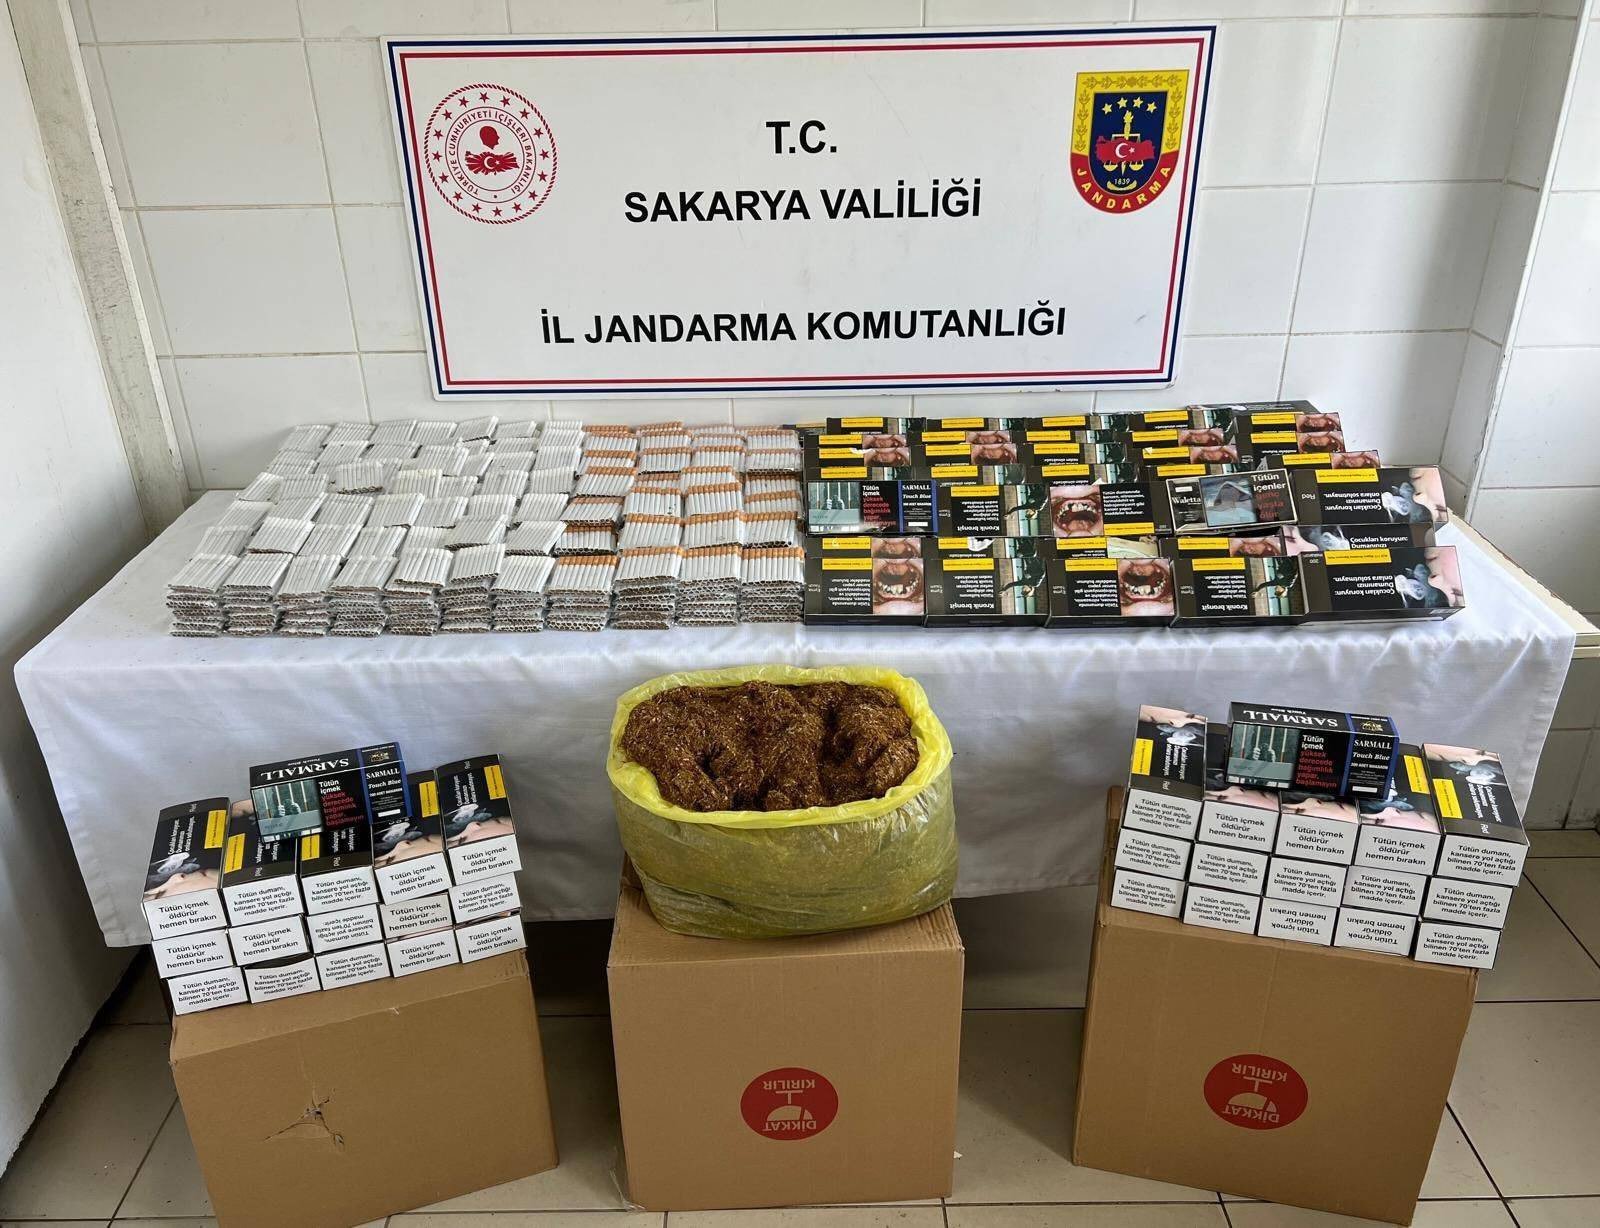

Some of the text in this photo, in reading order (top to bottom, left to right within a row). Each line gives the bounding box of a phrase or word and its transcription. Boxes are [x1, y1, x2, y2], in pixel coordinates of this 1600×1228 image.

[766, 121, 837, 154] T.C.
[449, 110, 532, 196] TÜRKİYE CUMHURİYETİ İÇİŞLERİ BAKANLIĞI
[1077, 167, 1171, 209] JANDARMA
[624, 178, 981, 222] SAKARYA VALİLİĞİ
[541, 300, 1066, 344] İL JANDARMA KOMUTANLIĞI
[1251, 474, 1279, 482] Tütün
[1253, 483, 1286, 492] içenler
[949, 602, 971, 610] bronşit
[1243, 710, 1338, 727] SARMALL
[1303, 734, 1324, 743] Tütün
[1354, 740, 1392, 749] SARMALL
[1302, 742, 1324, 751] içmek
[1301, 750, 1327, 758] yüksek
[1299, 757, 1332, 766] derecede
[261, 758, 349, 781] SARMALL
[366, 768, 400, 780] SARMALL
[1298, 765, 1333, 774] bağımlılık
[318, 779, 340, 787] Tütün
[368, 781, 387, 789] Touch
[1296, 778, 1337, 788] başlamayın
[320, 786, 341, 795] içmek
[323, 797, 354, 806] derecede
[1492, 805, 1502, 822] koruyun:
[1215, 813, 1265, 827] Tütün içmek
[1221, 822, 1250, 832] öldürür
[1292, 825, 1343, 839] Tütün içmek
[1480, 824, 1489, 834] Red
[1209, 828, 1265, 842] hemen bırakın
[1298, 834, 1329, 844] öldürür
[1286, 841, 1344, 854] hemen bırakın
[1372, 836, 1426, 850] Tütün içmek
[462, 845, 507, 861] Tütün içmek
[1378, 846, 1410, 855] öldürür
[1450, 851, 1480, 859] kansere
[1480, 848, 1512, 857] dumanı,
[470, 855, 497, 866] öldürür
[1365, 852, 1426, 865] hemen bırakın
[1472, 860, 1497, 868] 70'ten
[461, 858, 513, 875] hemen bırakın
[1455, 864, 1504, 876] madde içerir.
[1276, 872, 1304, 880] kansere
[1303, 870, 1331, 879] dumanı,
[1282, 886, 1326, 898] madde içerir.
[158, 899, 210, 913] Tütün içmek
[168, 909, 199, 919] öldürür
[1269, 907, 1325, 920] hemen bırakın
[159, 914, 217, 928] hemen bırakın
[1284, 917, 1313, 926] öldürür
[1270, 921, 1319, 934] Tütün içmek
[243, 926, 292, 942] Tütün içmek
[166, 940, 217, 954] Tütün içmek
[251, 936, 281, 947] öldürür
[243, 940, 299, 956] hemen bırakın
[175, 950, 206, 960] öldürür
[166, 954, 223, 969] hemen bırakın
[1232, 1063, 1288, 1082] KIRILIR
[763, 1079, 815, 1089] KIRILIR
[1221, 1105, 1280, 1123] DİKKAT
[762, 1120, 817, 1132] DİKKAT
